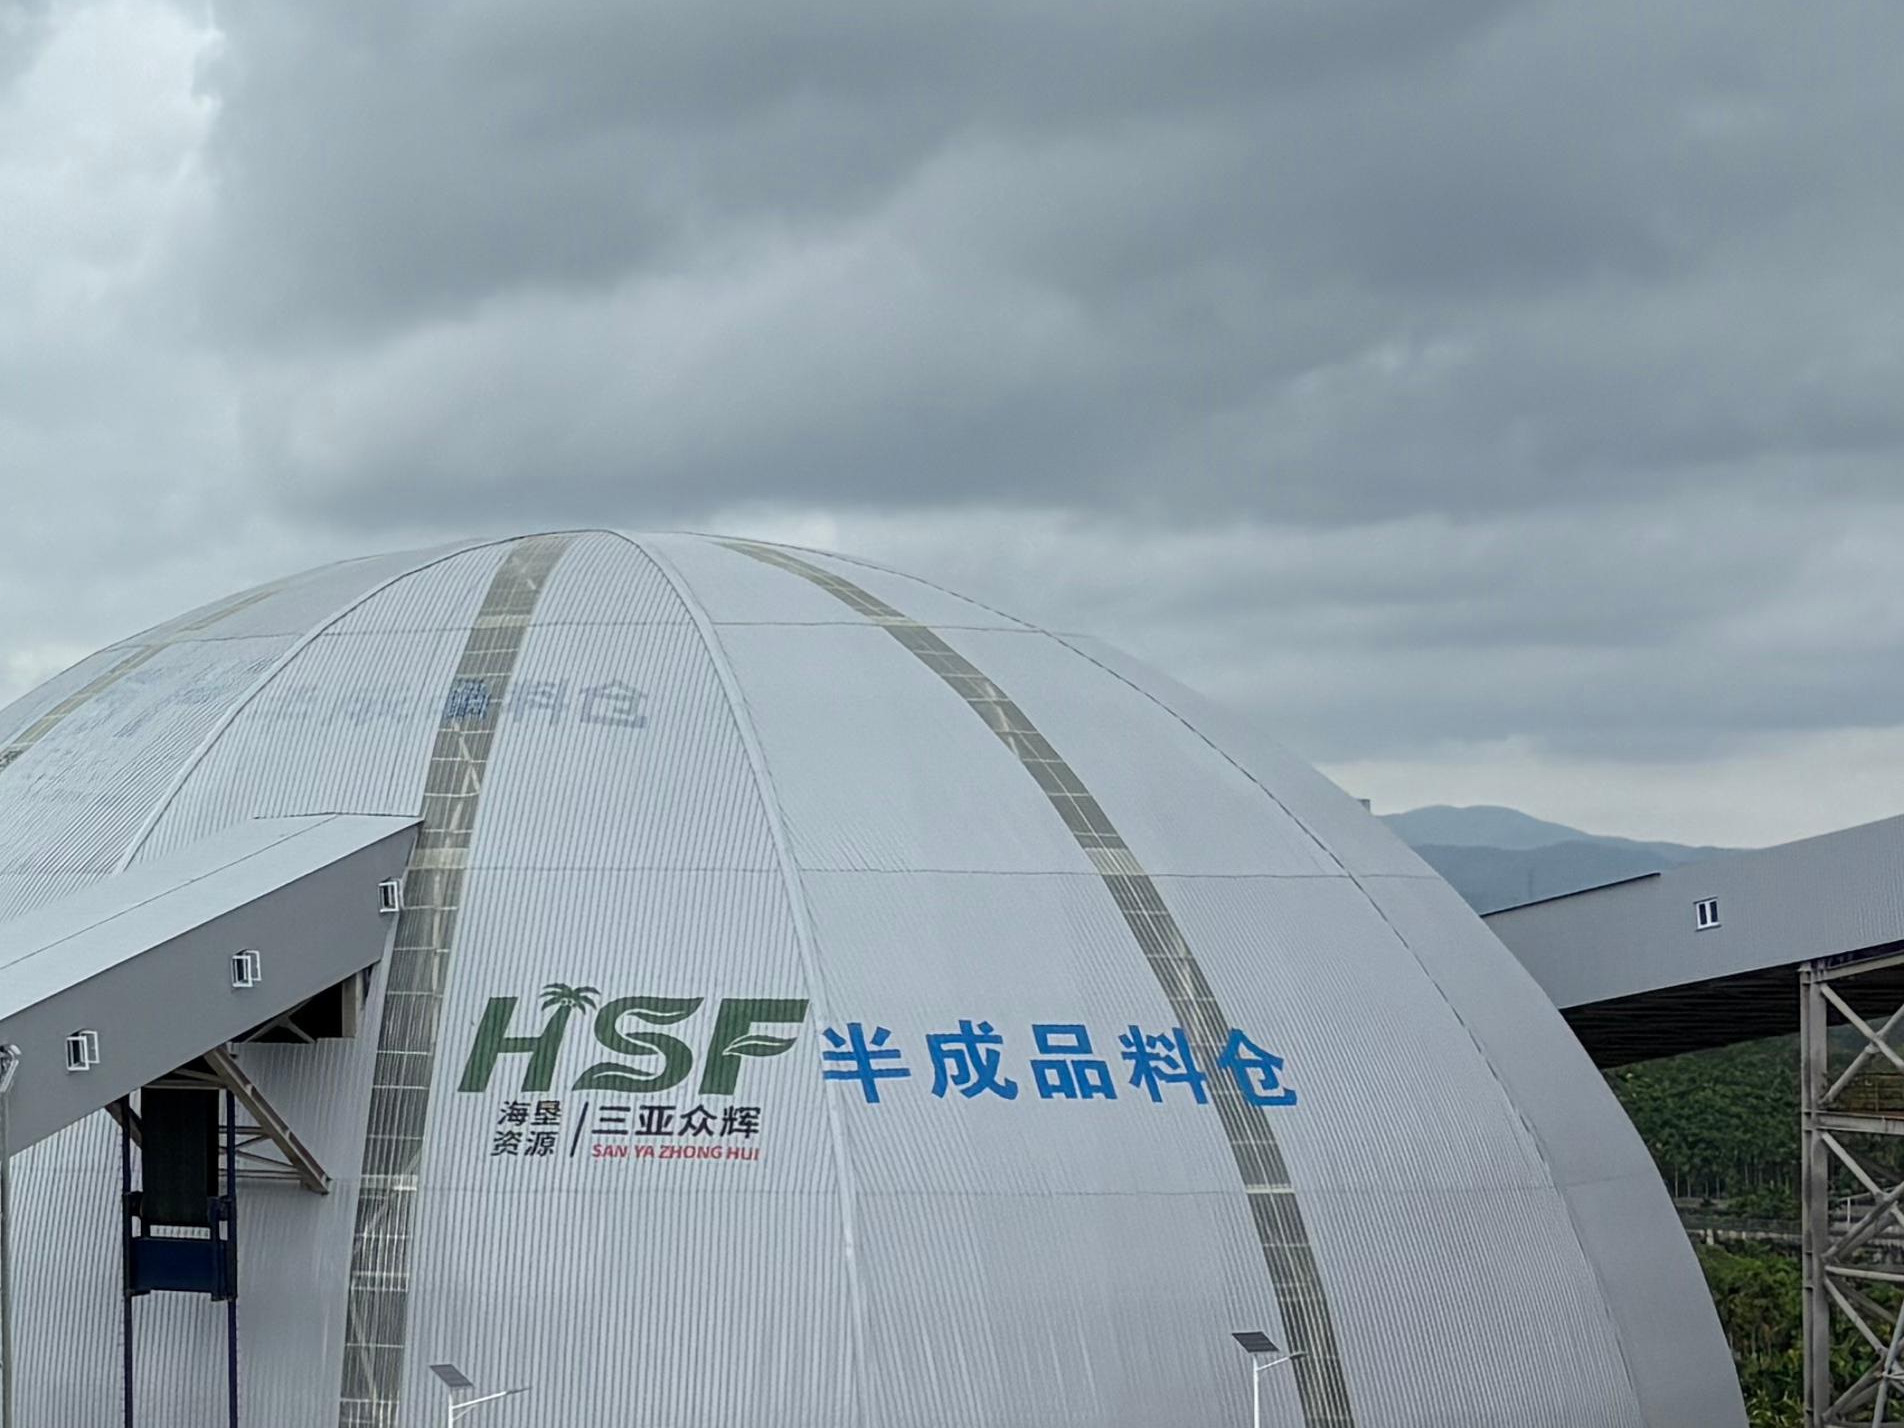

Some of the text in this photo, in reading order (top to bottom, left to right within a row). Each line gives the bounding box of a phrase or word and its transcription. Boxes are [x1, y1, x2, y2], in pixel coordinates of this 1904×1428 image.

[457, 984, 809, 1095] HSF
[823, 1020, 1297, 1106] 半成品料仓
[498, 1100, 562, 1127] 海垦
[592, 1105, 761, 1138] 三亚众辉
[491, 1131, 558, 1157] 资源
[592, 1144, 759, 1161] SAN YA ZHONG HUI
